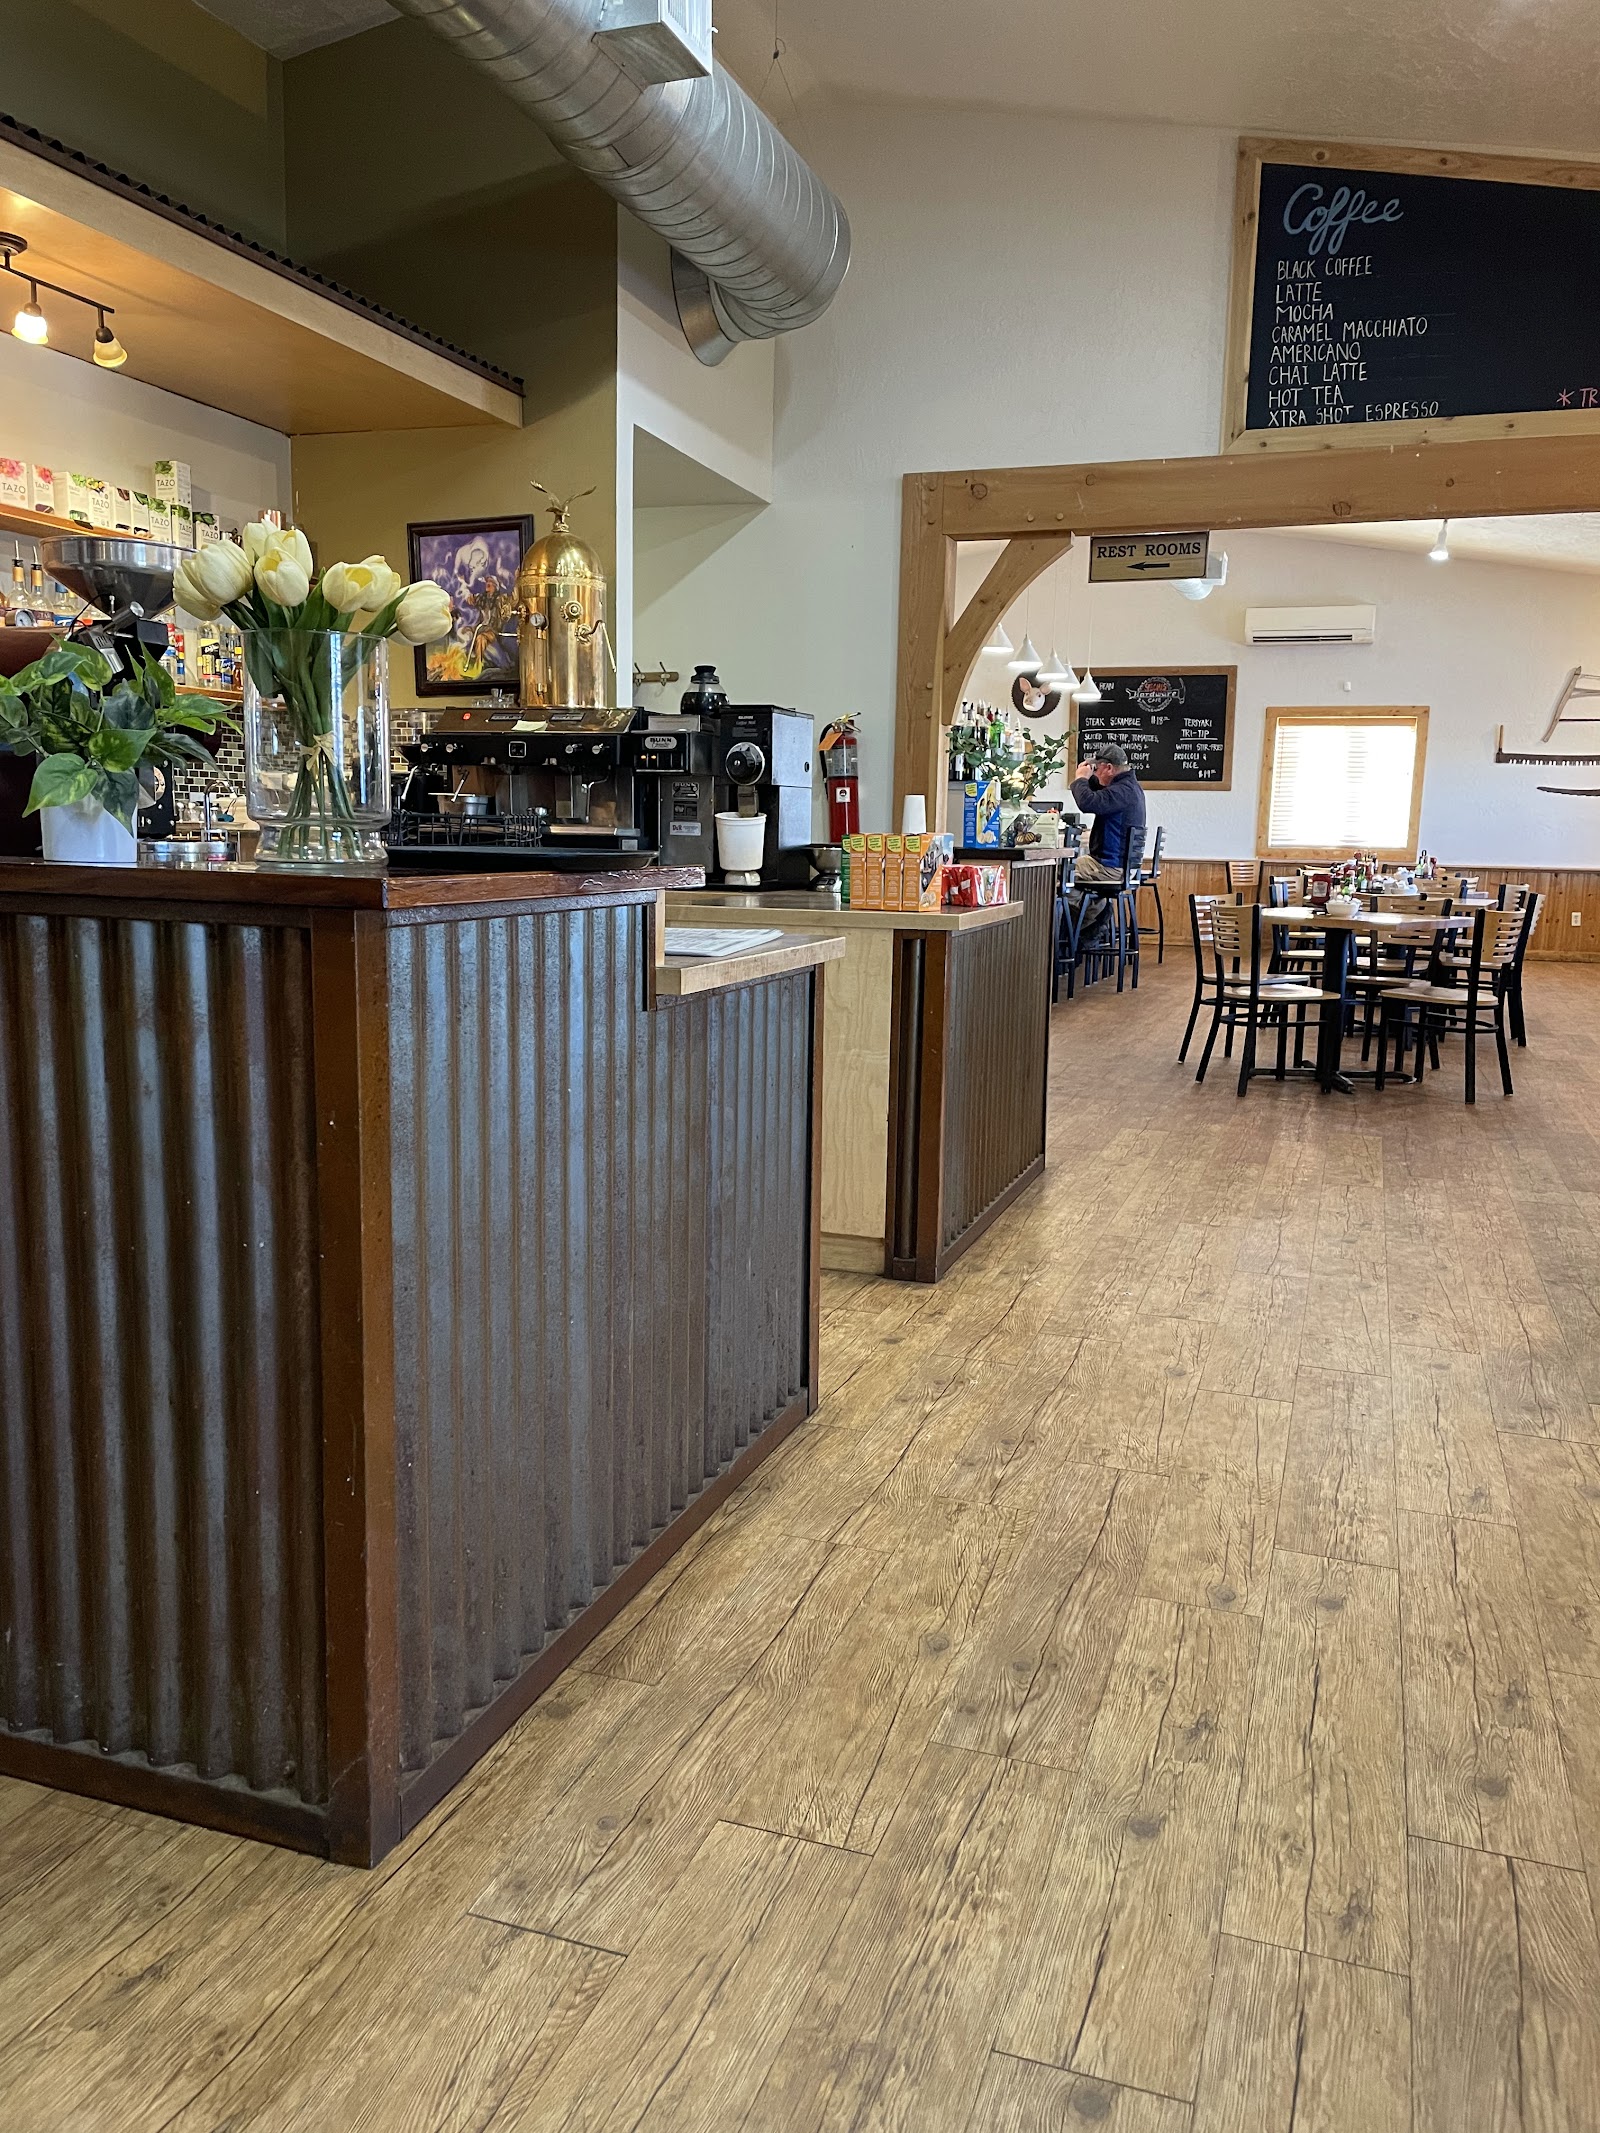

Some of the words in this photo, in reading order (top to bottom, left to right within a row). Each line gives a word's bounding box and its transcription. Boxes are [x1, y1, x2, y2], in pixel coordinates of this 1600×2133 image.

[1283, 183, 1404, 255] Coffee
[1277, 260, 1316, 280] BLACK
[1325, 256, 1373, 277] COFFEE
[1276, 282, 1322, 304] LATTE
[1276, 303, 1334, 323] MOCHA
[1272, 323, 1333, 344] CARAMEL
[1342, 317, 1428, 342] MACCHIATO
[1270, 342, 1361, 363] AMERICANO
[1269, 366, 1310, 385] CHAI
[1323, 362, 1368, 382] LATTE
[1269, 388, 1303, 408] HOT
[1311, 385, 1344, 405] TEA
[1268, 409, 1307, 427] XTRA
[1316, 405, 1354, 425] SHOT
[1366, 401, 1440, 422] ESPRESSO
[2, 482, 26, 494] TAZO
[35, 481, 50, 491] TAZO
[156, 479, 175, 487] TAZO
[92, 497, 110, 509] TAZO
[150, 516, 170, 527] TAZO
[201, 529, 219, 540] TAZO
[1097, 545, 1137, 559] REST
[1145, 542, 1201, 556] ROOMS
[1085, 717, 1105, 726] STEAK
[1110, 717, 1141, 726] SCRAMBLE
[1181, 729, 1210, 738] TRI-TIP
